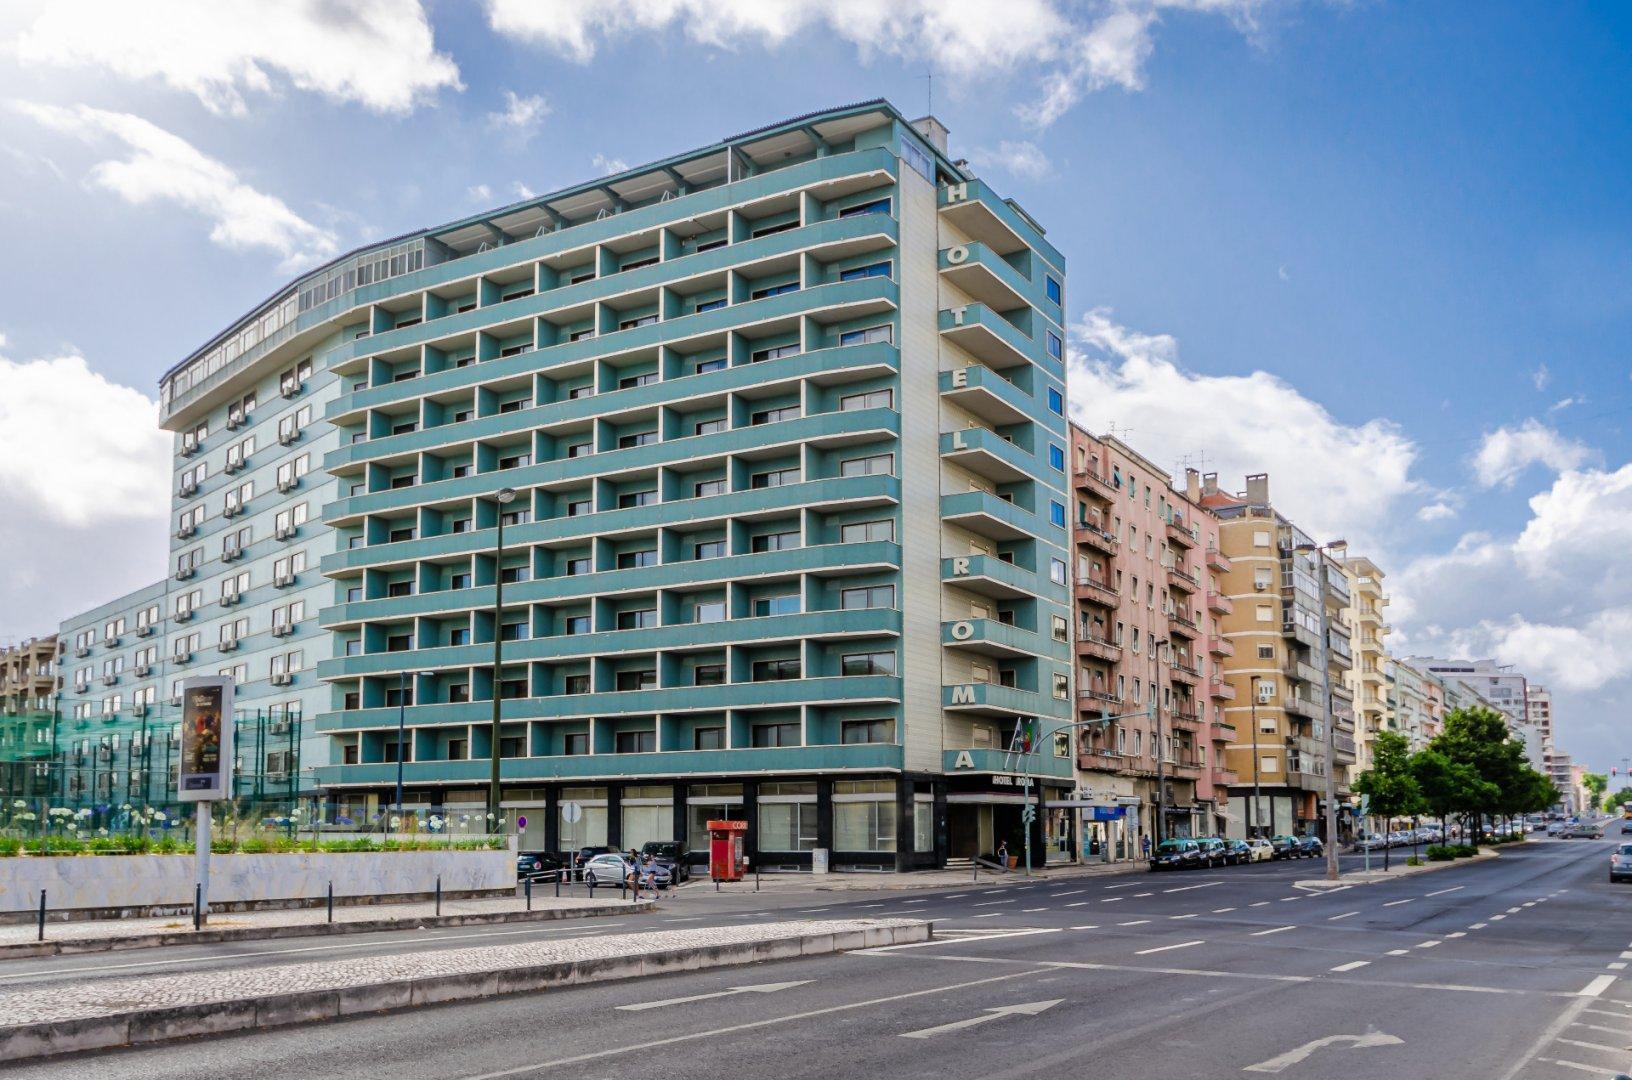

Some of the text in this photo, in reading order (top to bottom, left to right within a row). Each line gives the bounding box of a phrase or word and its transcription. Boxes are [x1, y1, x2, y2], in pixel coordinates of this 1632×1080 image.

[946, 182, 976, 769] HOTEL ROMA
[992, 775, 1013, 786] HOTEL
